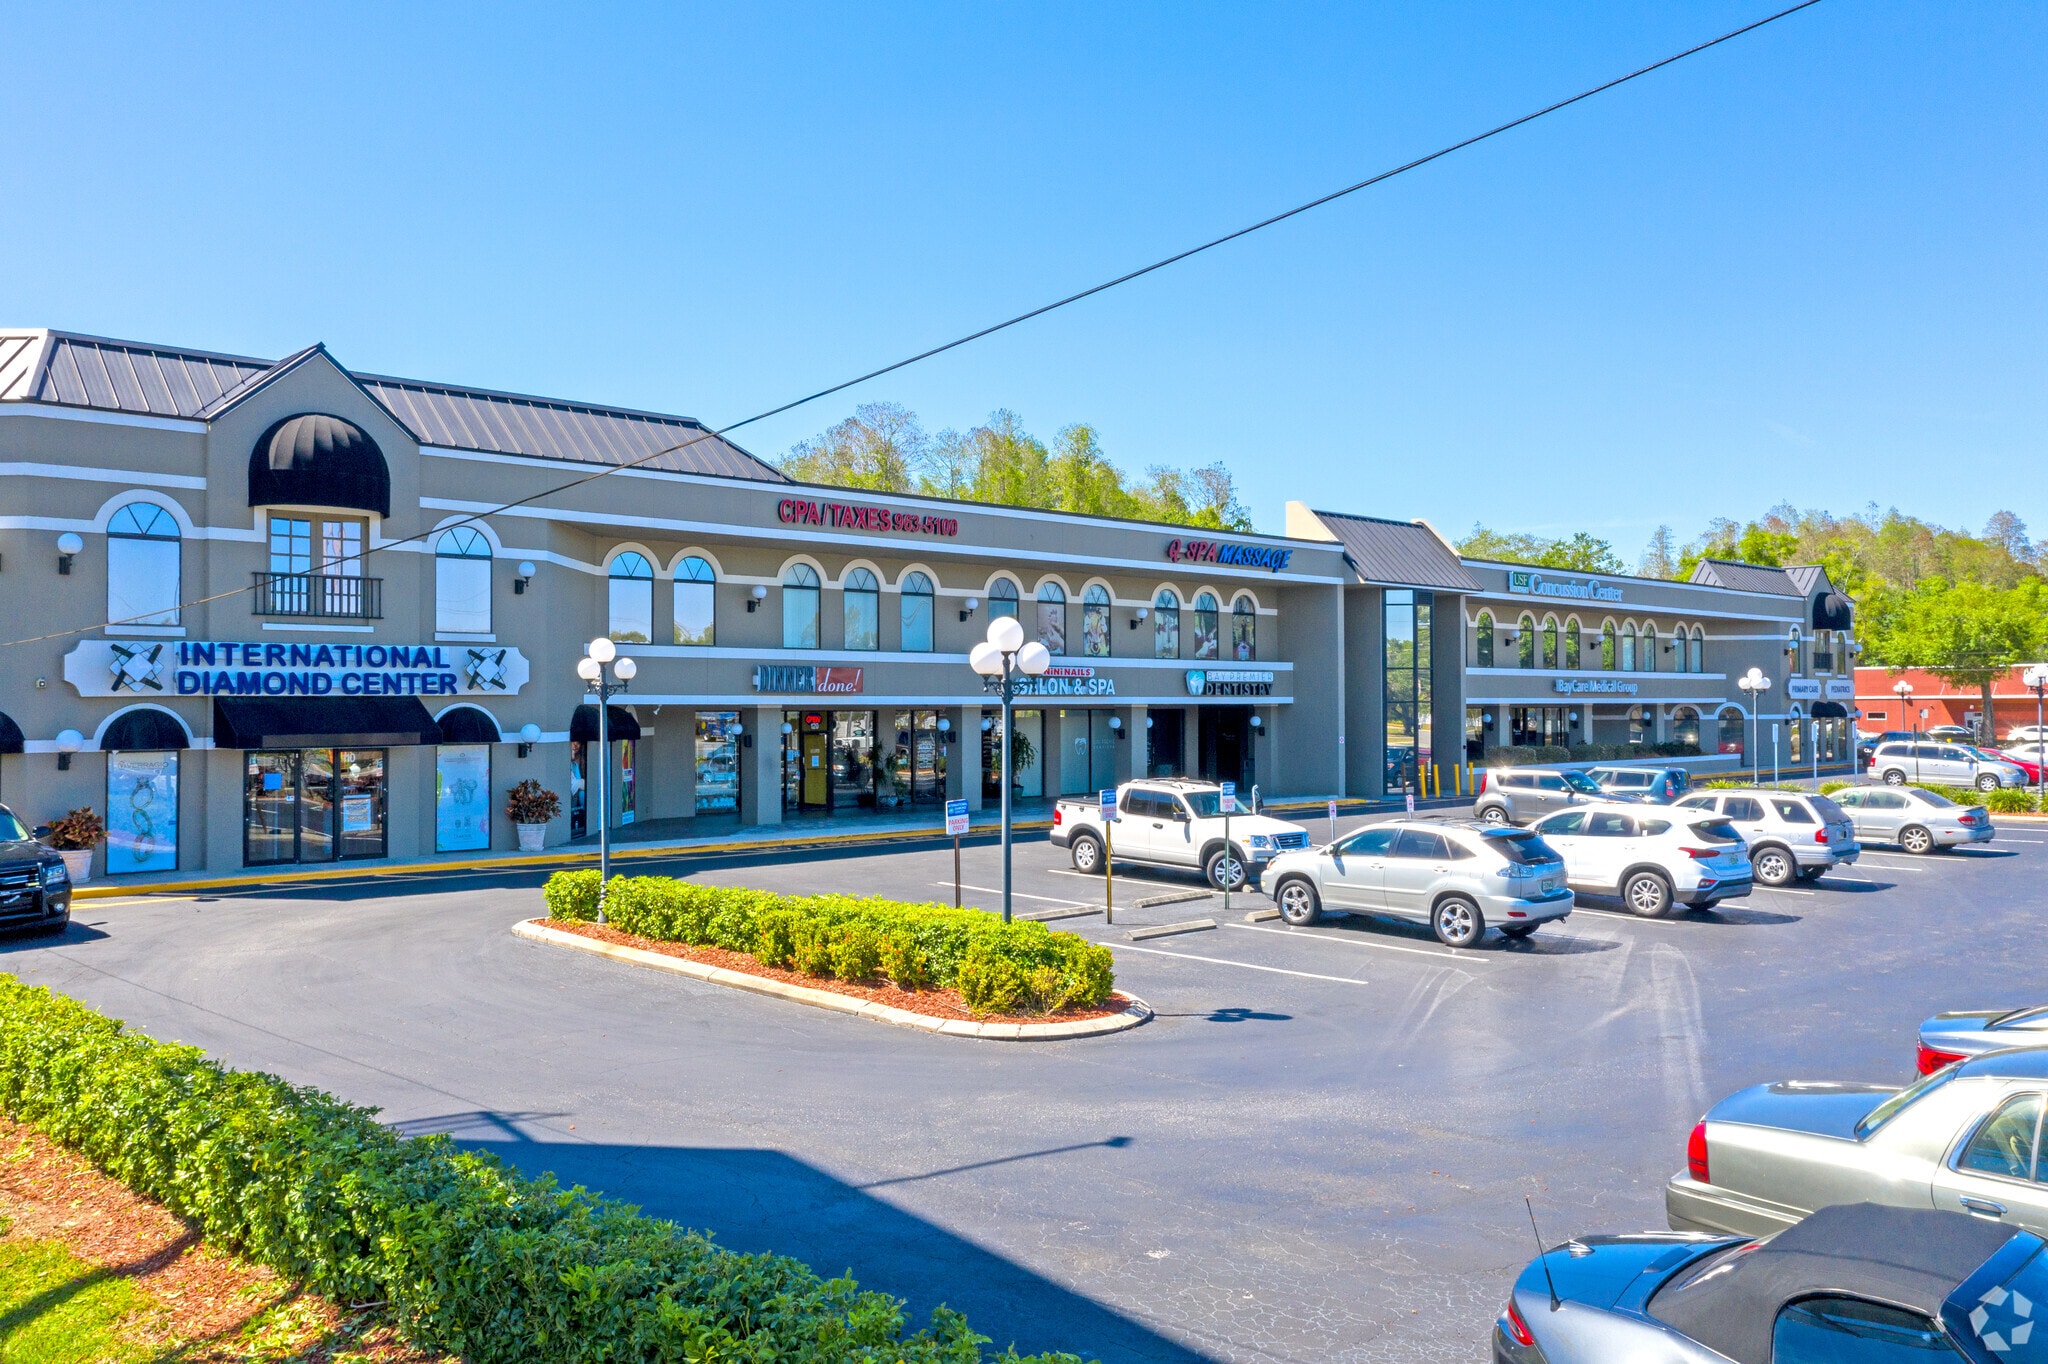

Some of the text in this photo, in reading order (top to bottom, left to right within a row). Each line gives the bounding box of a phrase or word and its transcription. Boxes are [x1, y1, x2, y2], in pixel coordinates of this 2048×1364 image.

[779, 498, 958, 537] CPA/TAXES 963-5100
[1167, 538, 1293, 573] Q SPA MASSAGE
[1513, 573, 1528, 586] USF
[1529, 573, 1624, 601] Concussion Center
[180, 642, 450, 668] INTERNATIONAL
[759, 665, 862, 692] DINNER done!
[1064, 668, 1091, 676] NAILS
[1207, 671, 1272, 681] BAY PREMIER
[177, 671, 458, 695] DIAMOND CENTER
[1073, 678, 1084, 695] &
[1088, 679, 1116, 695] SPA
[1206, 683, 1273, 695] DENTISTRY
[1557, 680, 1638, 696] BayCare Medical Group
[806, 715, 821, 723] OPEN
